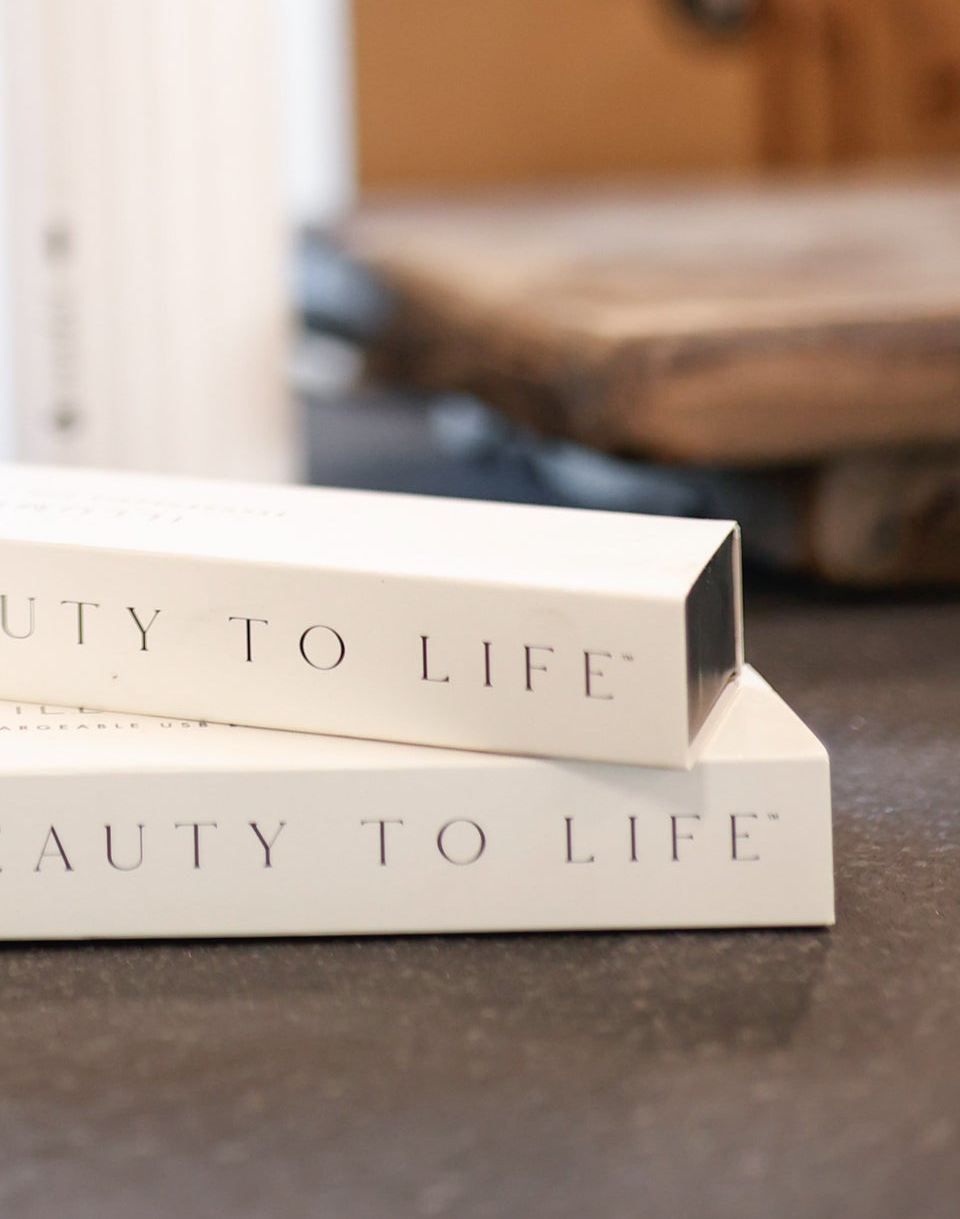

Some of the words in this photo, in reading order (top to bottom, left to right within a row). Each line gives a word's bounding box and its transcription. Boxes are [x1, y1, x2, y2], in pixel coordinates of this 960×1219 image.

[228, 616, 347, 671] TO
[160, 719, 209, 729] USB
[359, 817, 487, 867] TO
